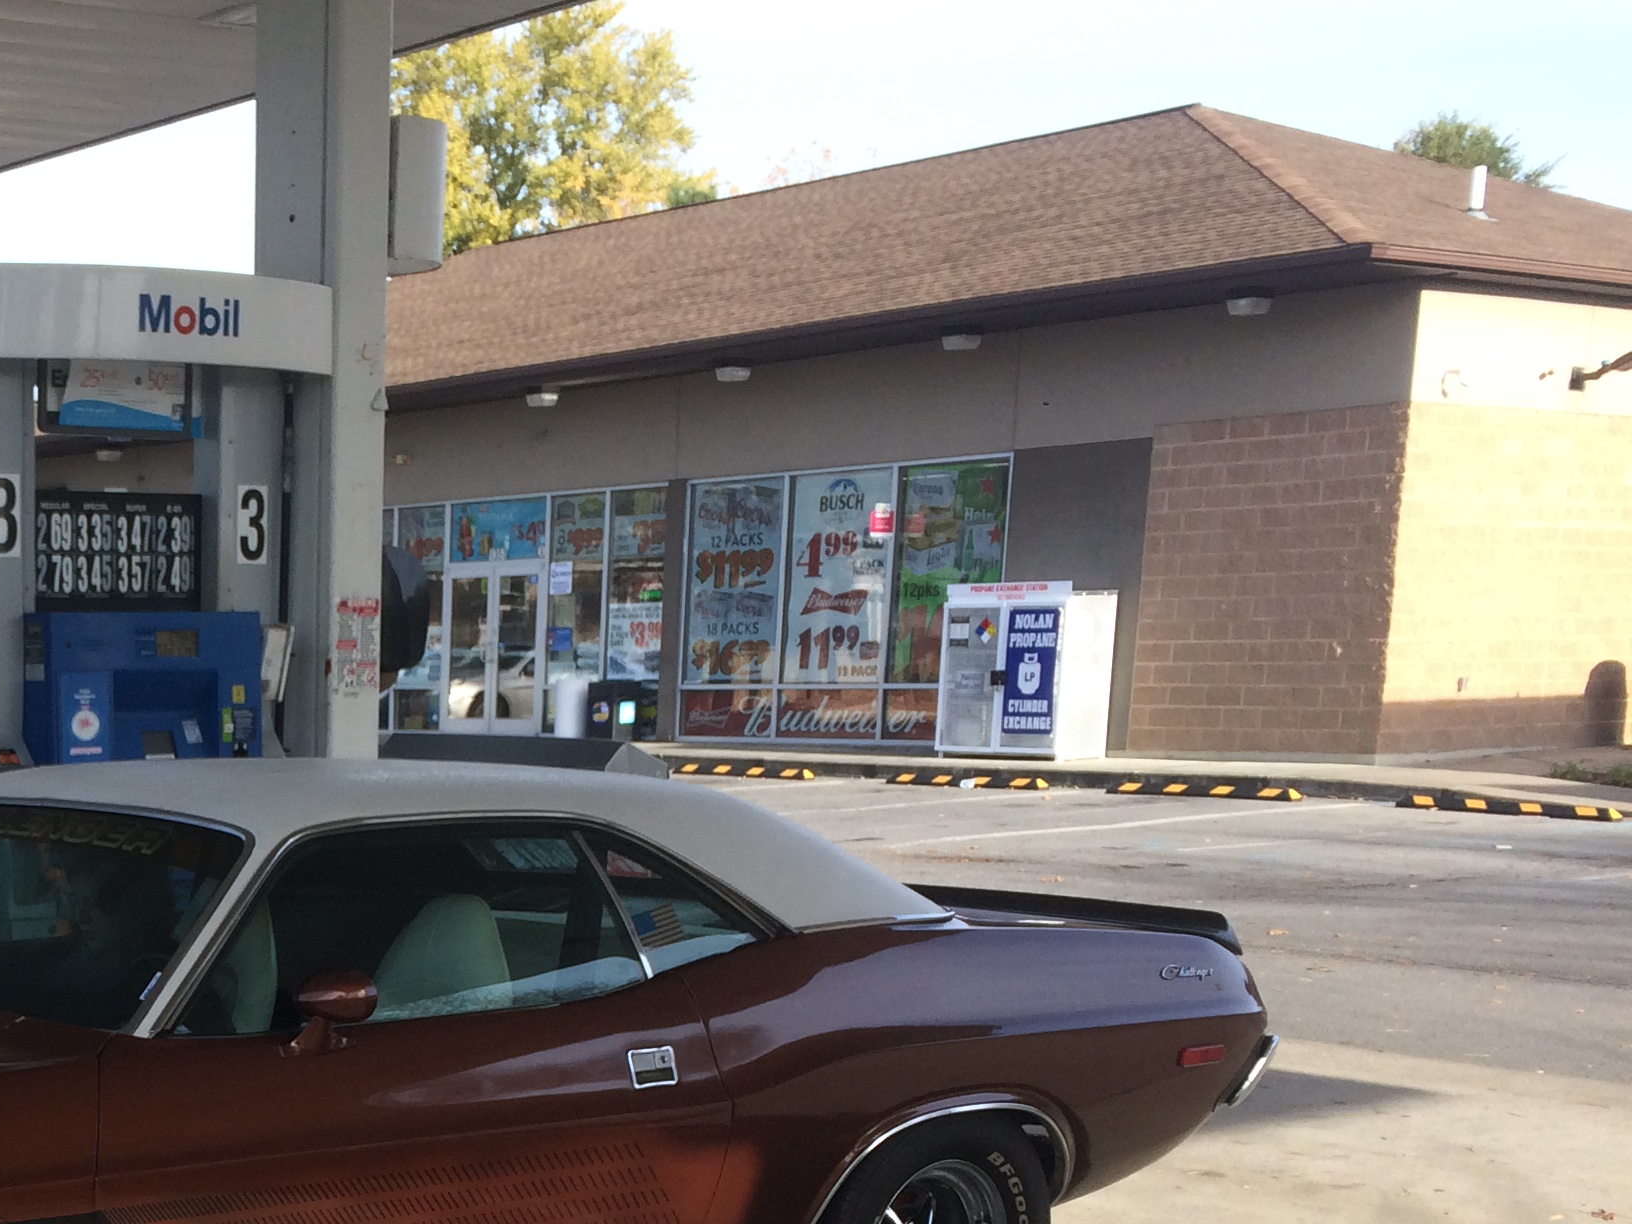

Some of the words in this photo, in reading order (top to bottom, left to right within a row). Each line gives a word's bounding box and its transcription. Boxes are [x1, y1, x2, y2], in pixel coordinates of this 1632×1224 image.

[138, 293, 240, 337] Mobil
[819, 493, 865, 512] BUSCH
[240, 489, 265, 561] 3
[711, 536, 722, 548] 12
[725, 532, 763, 547] PACKS
[707, 623, 718, 635] 18
[721, 622, 759, 635] PACKS
[1014, 614, 1054, 629] NOLAN
[1009, 633, 1056, 648] PROPANE
[1024, 672, 1035, 682] LP
[1008, 700, 1048, 713] CYLINDER
[1003, 716, 1051, 730] EXCHANGE
